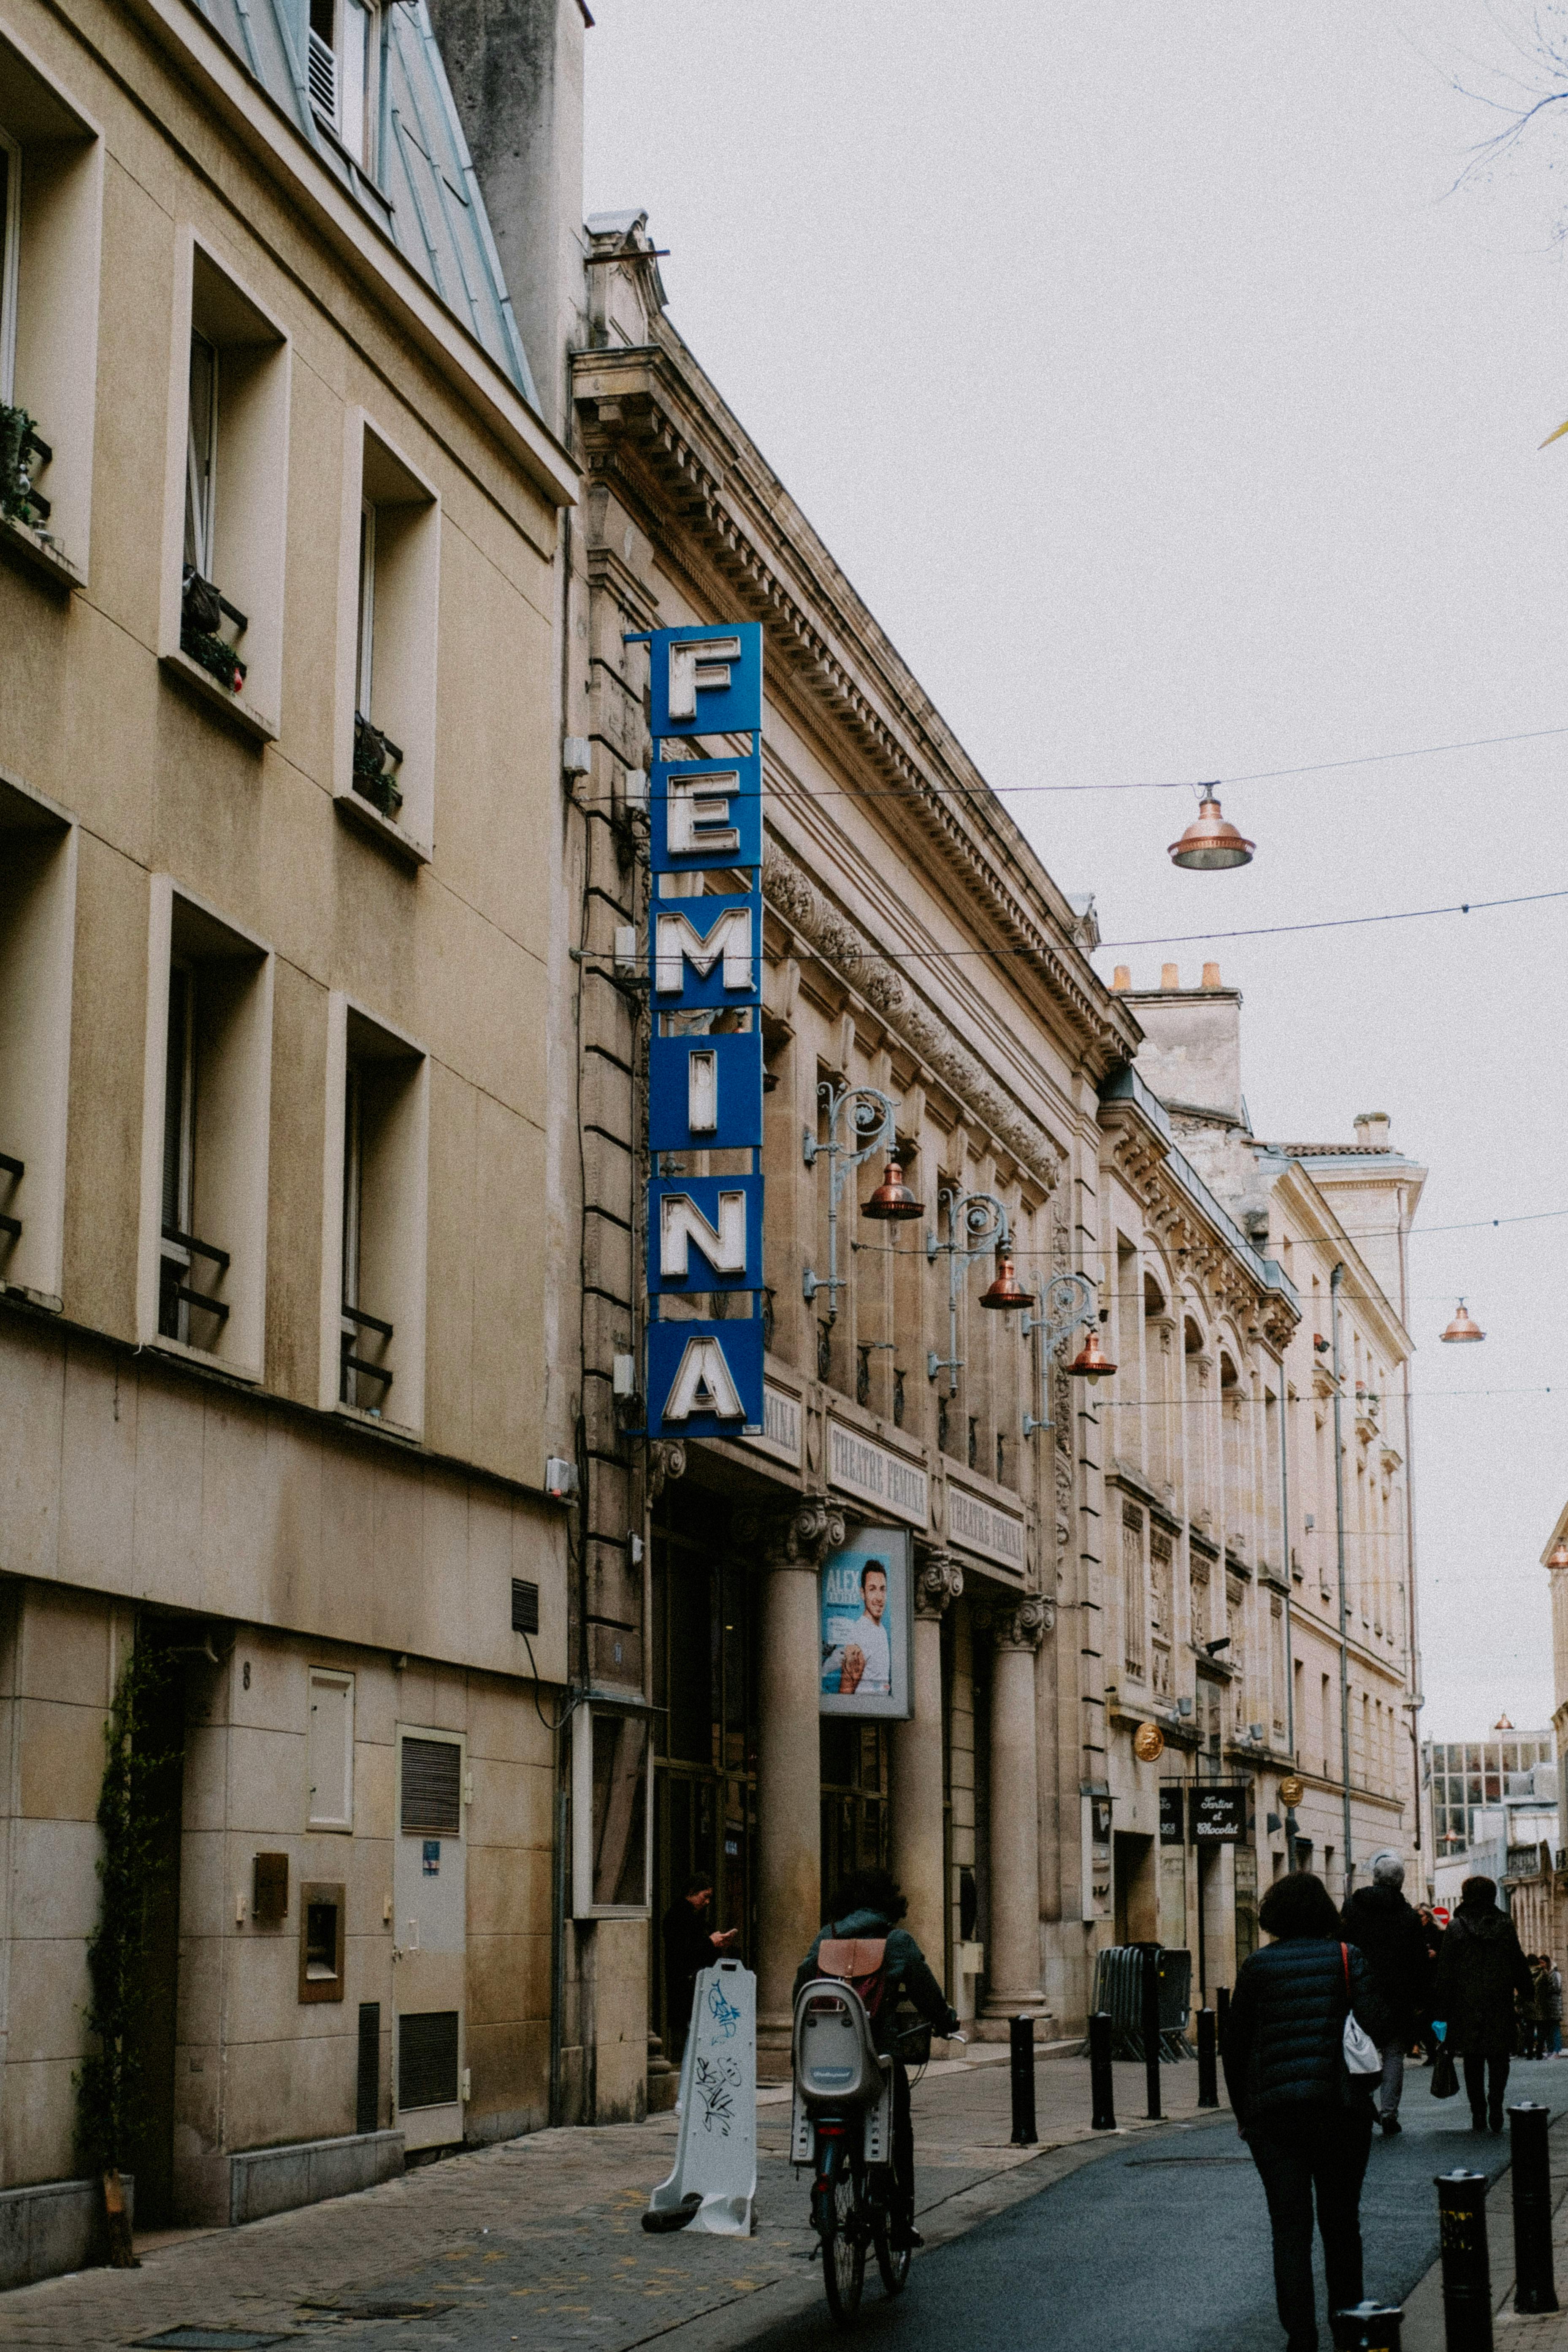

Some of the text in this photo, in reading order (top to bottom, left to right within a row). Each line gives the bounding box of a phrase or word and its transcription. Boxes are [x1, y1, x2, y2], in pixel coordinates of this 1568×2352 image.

[655, 636, 752, 1421] FEMINA
[764, 1392, 796, 1452] MINA
[827, 1569, 860, 1593] ALEX
[243, 1661, 250, 1691] 8
[1201, 1796, 1234, 1809] Tartine
[1197, 1822, 1239, 1834] Chocolat
[1213, 1811, 1222, 1821] et
